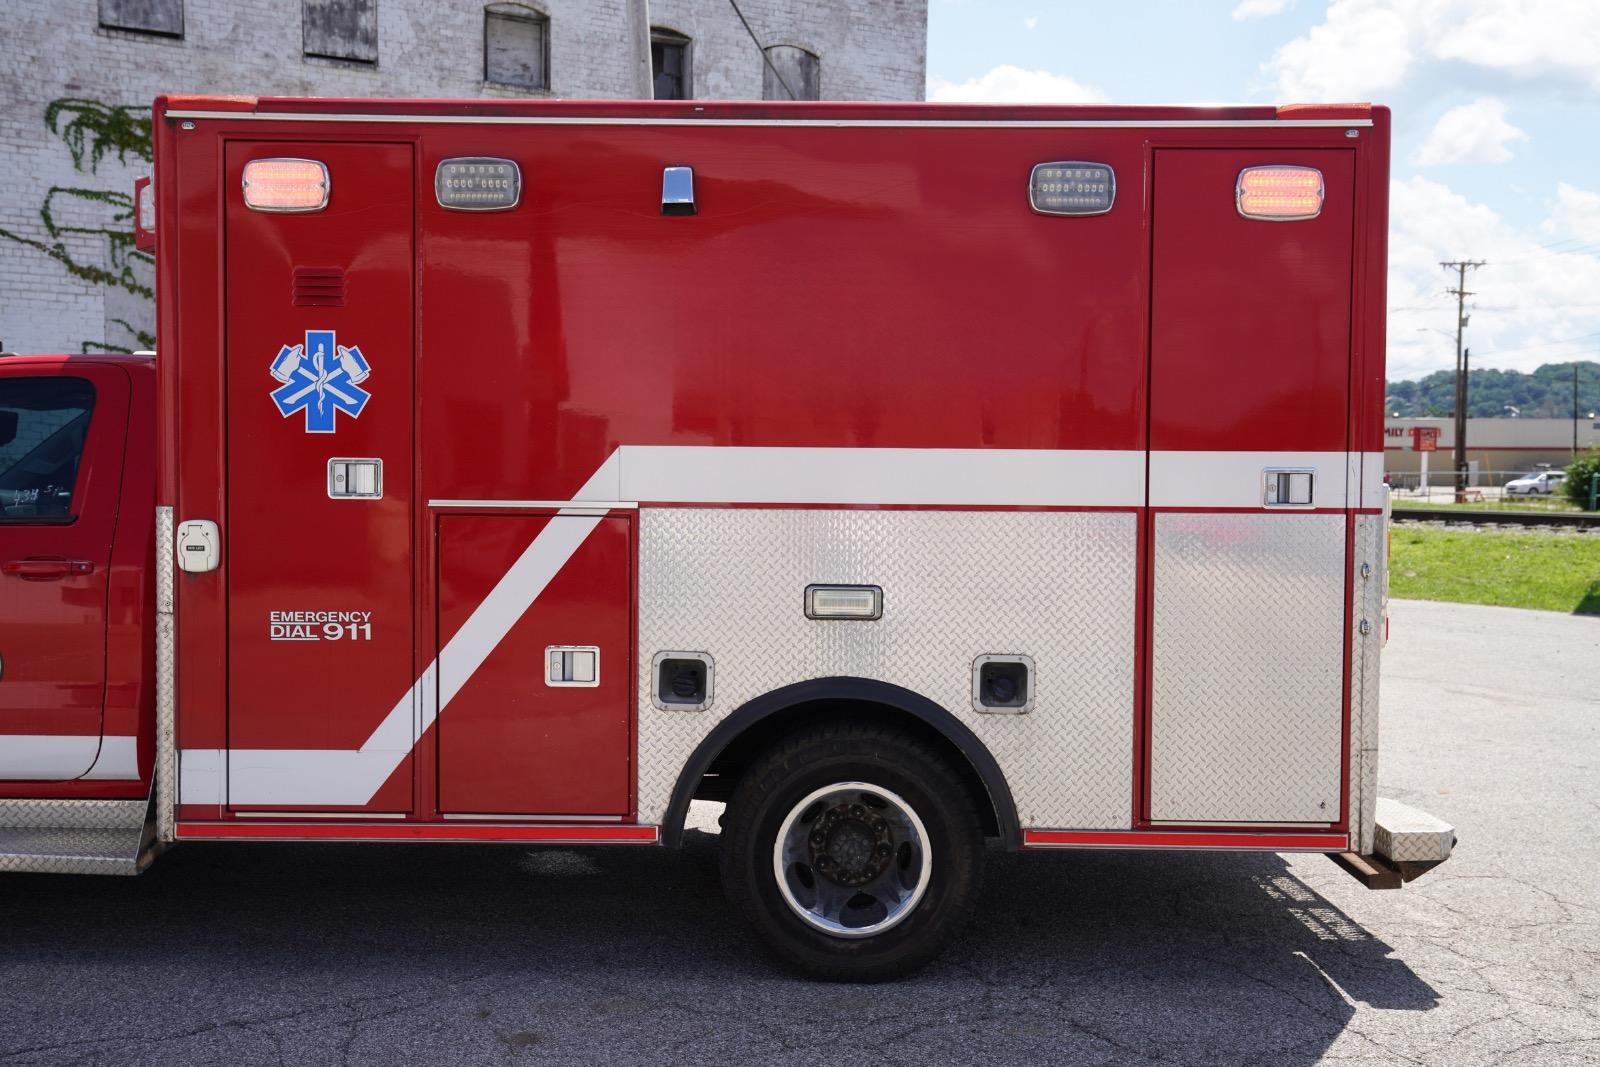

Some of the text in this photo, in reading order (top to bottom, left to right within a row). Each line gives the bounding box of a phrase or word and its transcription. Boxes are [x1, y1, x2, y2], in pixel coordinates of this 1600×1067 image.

[270, 611, 372, 622] EMERGENCY
[270, 622, 372, 641] DIAL 911
